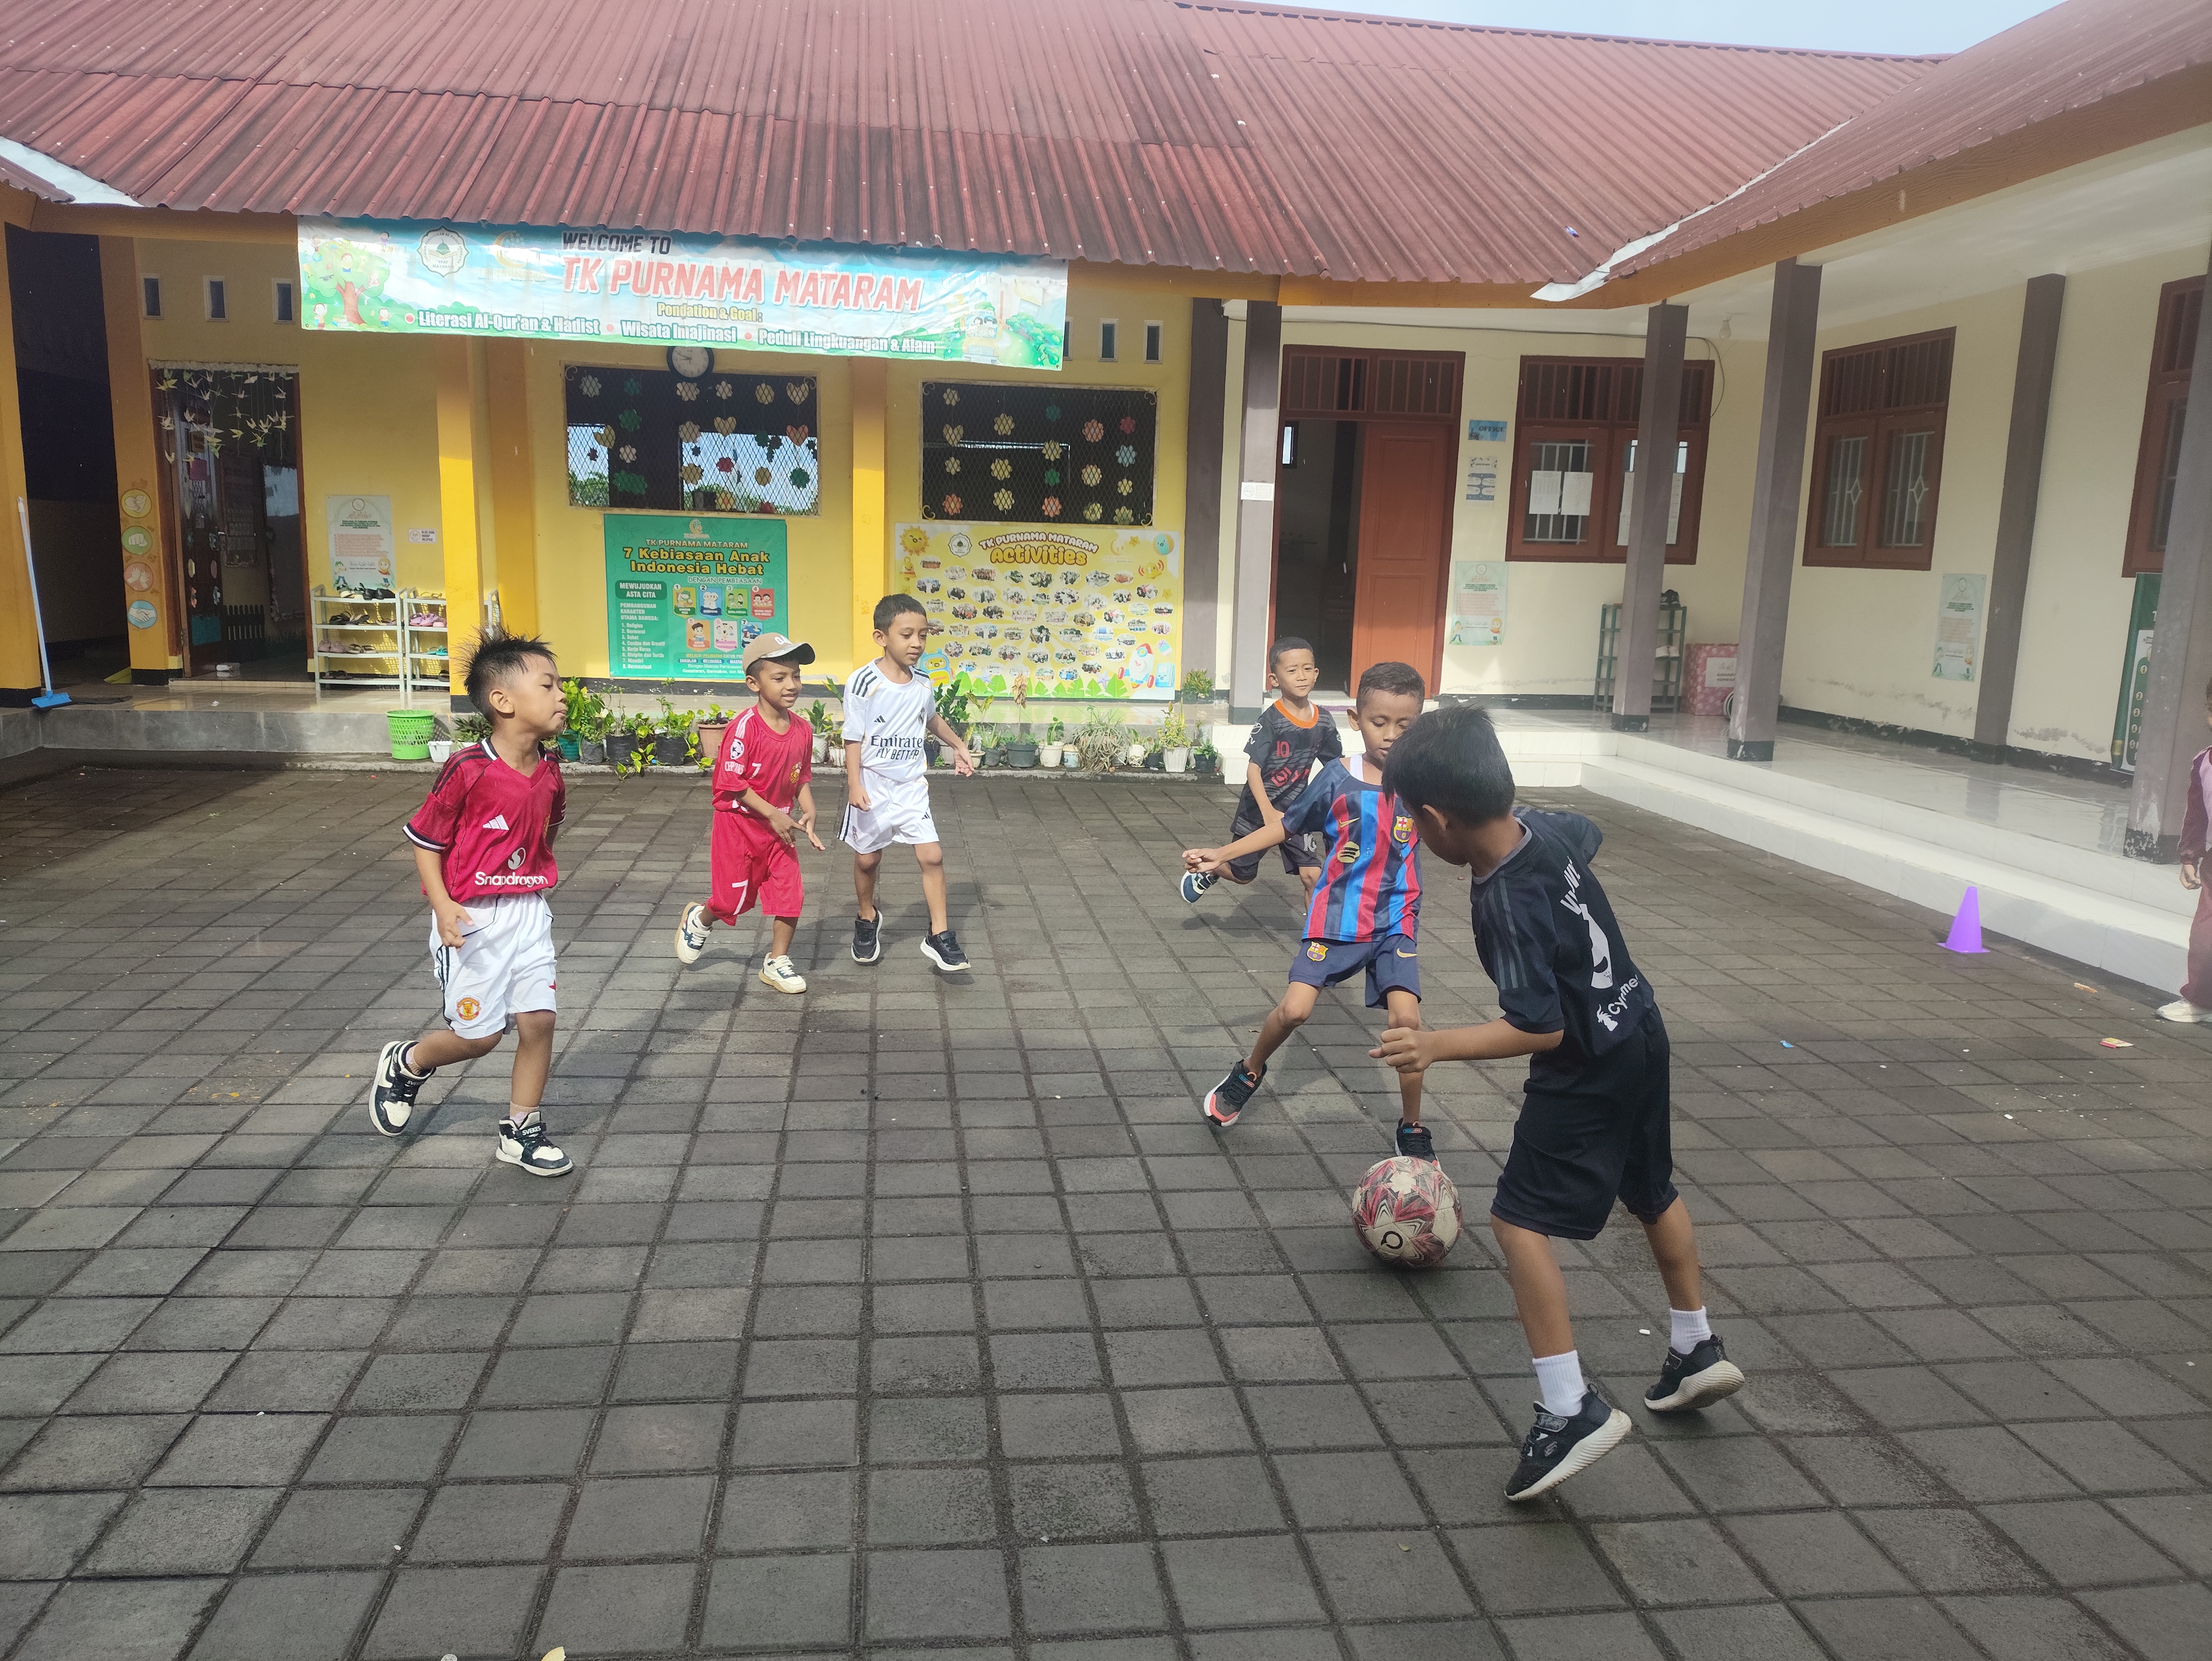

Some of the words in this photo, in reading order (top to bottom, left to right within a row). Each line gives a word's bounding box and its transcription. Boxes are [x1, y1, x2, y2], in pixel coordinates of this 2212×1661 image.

[563, 233, 644, 253] WELCOME
[650, 236, 671, 255] TO
[563, 256, 603, 290] TK
[610, 260, 764, 301] PURNAMA
[774, 270, 922, 311] MATARAM
[657, 302, 718, 319] Pondation
[719, 307, 729, 320] &
[418, 310, 473, 329] Literasi
[474, 312, 539, 331] Al-Qur'an
[541, 317, 552, 332] &
[553, 315, 601, 335] Hadist
[620, 319, 672, 340] Wisata
[672, 322, 738, 343] Imajinasi
[758, 328, 802, 347] Peduli
[803, 332, 888, 352] Lingkuangan
[890, 338, 900, 352] &
[901, 337, 936, 354] Alam
[658, 539, 702, 548] PURNAMA
[703, 541, 748, 549] MATARAM
[979, 538, 995, 550] TK
[995, 532, 1047, 545] PURNAMA
[1048, 532, 1099, 554] MATARAM
[623, 547, 632, 558] 7
[639, 548, 724, 562] Kebiasaan
[730, 550, 770, 563] Anak
[630, 561, 710, 574] Indonesia
[716, 563, 764, 575] Hebat
[718, 576, 763, 585] PEMBIASAAN
[871, 734, 923, 748] Emirate
[1276, 740, 1290, 758] 10
[876, 748, 891, 758] FLY
[890, 749, 919, 760] BETTER
[750, 762, 762, 779] 7
[475, 871, 549, 887] Snapdragon
[731, 879, 749, 916] 7
